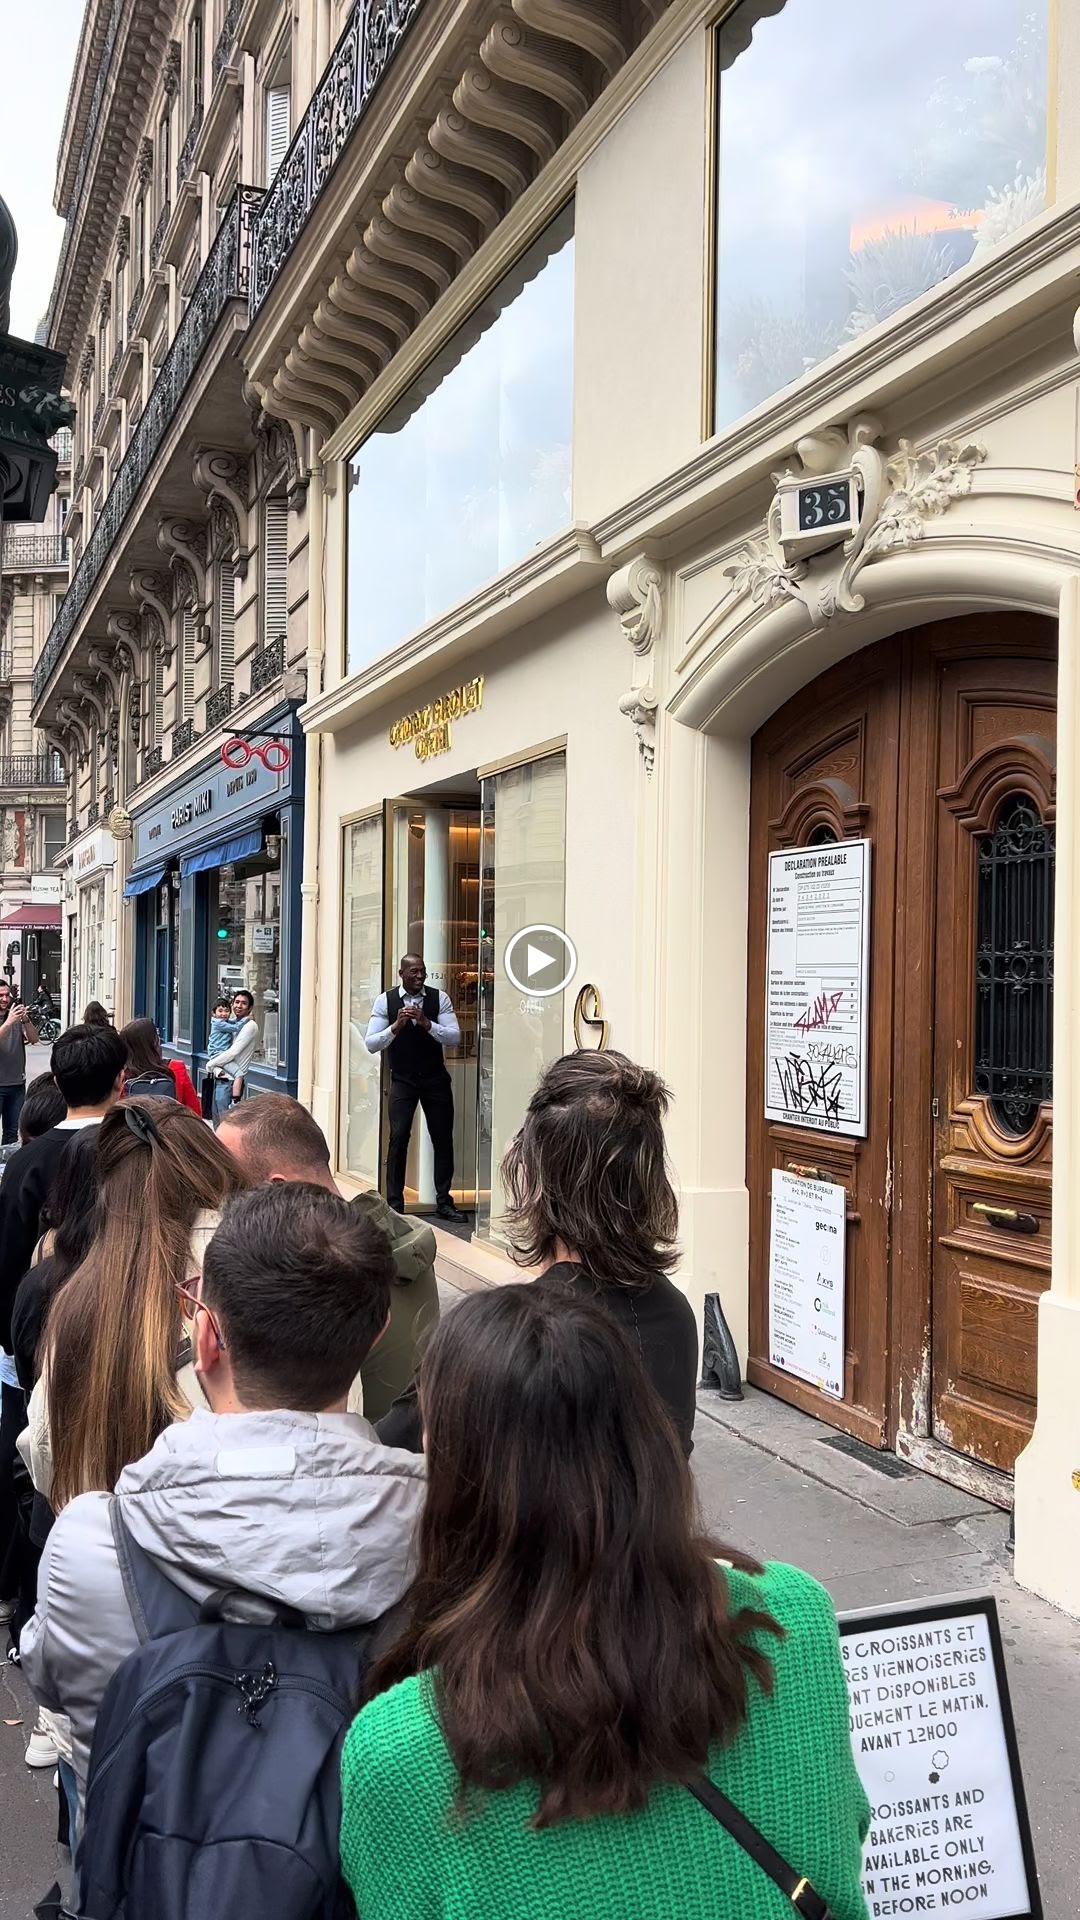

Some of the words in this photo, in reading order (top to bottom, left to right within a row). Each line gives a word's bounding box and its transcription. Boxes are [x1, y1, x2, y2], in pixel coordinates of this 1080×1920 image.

[804, 486, 846, 525] 35
[171, 802, 192, 829] PARIS
[193, 789, 212, 816] MIKI
[818, 1119, 824, 1127] AU
[957, 1625, 975, 1641] ET
[849, 1688, 871, 1706] NT
[919, 1701, 937, 1718] LE
[861, 1731, 901, 1752] AVANT
[955, 1789, 985, 1806] AND
[945, 1814, 973, 1833] ARE
[945, 1836, 984, 1857] ONLY
[880, 1874, 910, 1892] THE
[873, 1894, 936, 1917] BEFORE
[941, 1883, 988, 1906] NOON
